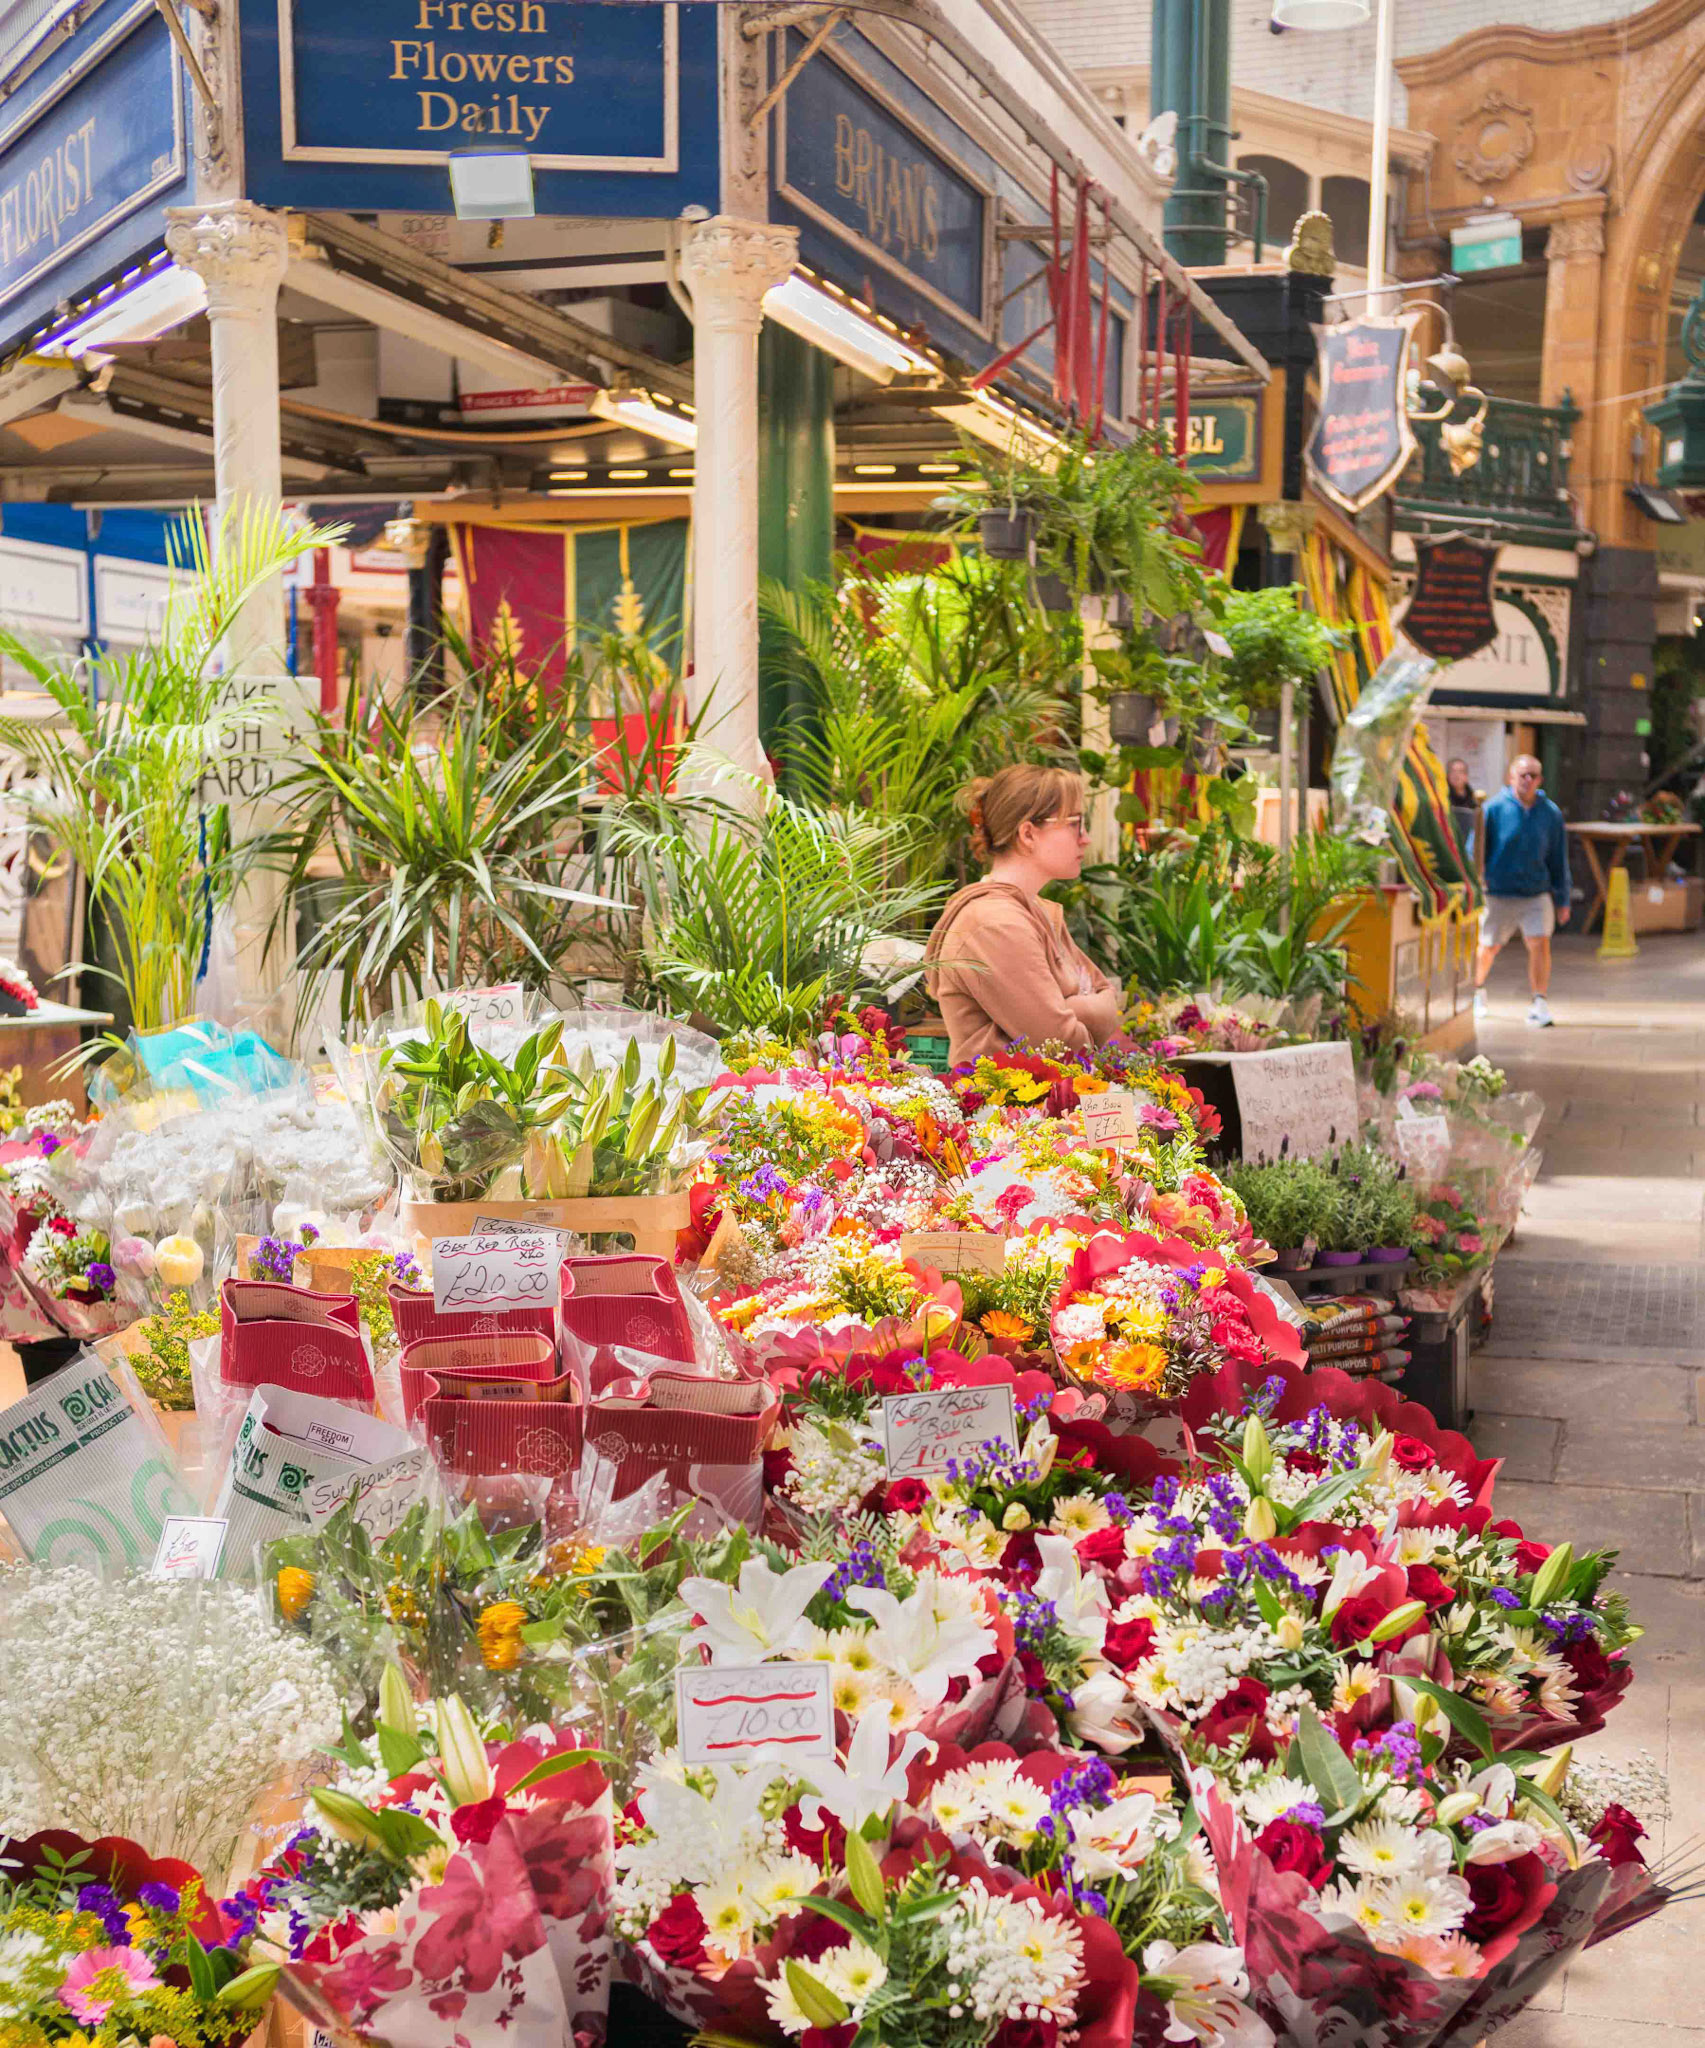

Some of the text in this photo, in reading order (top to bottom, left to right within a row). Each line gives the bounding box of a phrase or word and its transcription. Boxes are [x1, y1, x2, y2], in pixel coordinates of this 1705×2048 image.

[414, 0, 548, 33] Fresh
[388, 40, 575, 84] Flowers
[416, 91, 552, 142] Daily
[0, 117, 96, 267] FLORIST
[311, 1425, 350, 1444] FREEDOM
